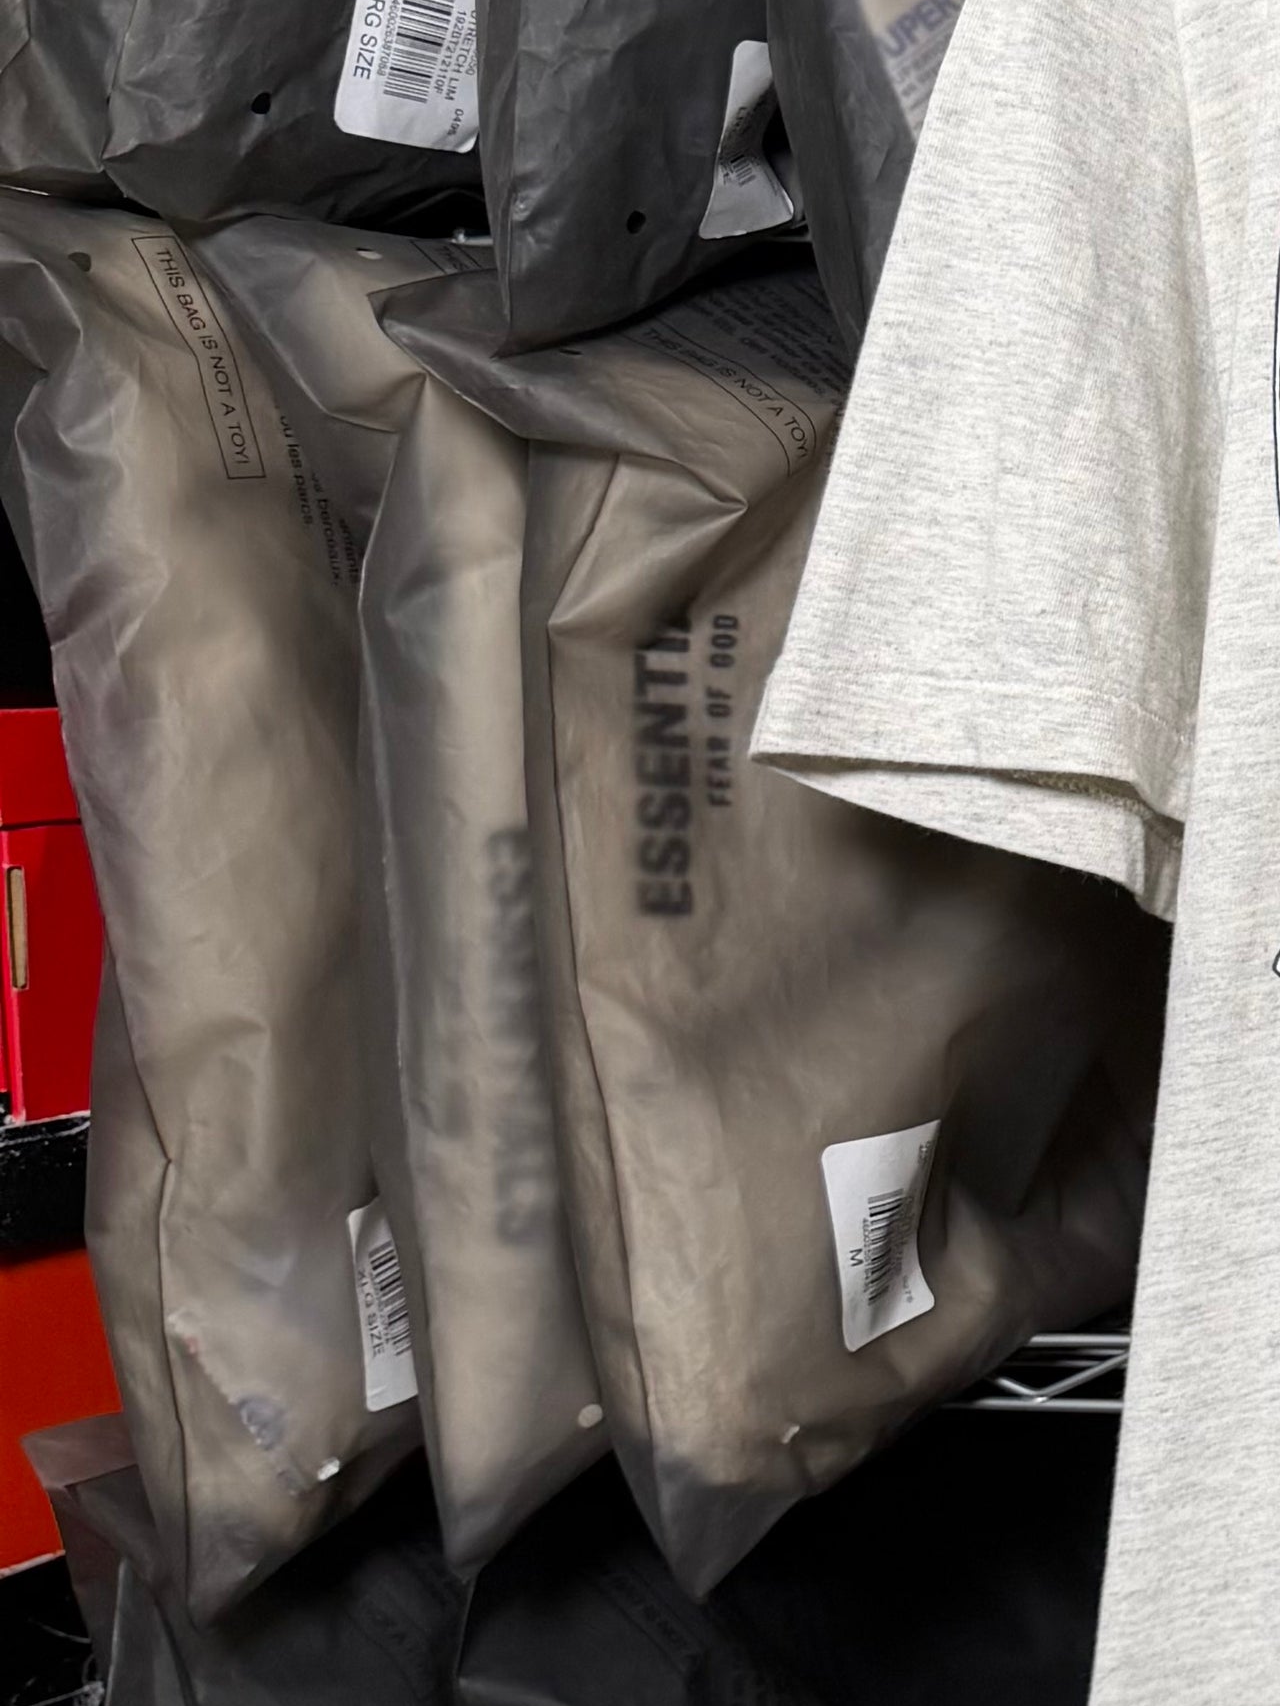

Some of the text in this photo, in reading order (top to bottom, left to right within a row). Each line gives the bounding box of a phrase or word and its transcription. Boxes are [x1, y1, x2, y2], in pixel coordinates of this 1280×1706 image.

[353, 33, 378, 80] SIZE
[156, 249, 250, 464] THIS BAG IS NOT A TOY!
[734, 378, 772, 404] NOT
[768, 405, 784, 417] A
[710, 614, 740, 669] GOD
[850, 1248, 863, 1266] M
